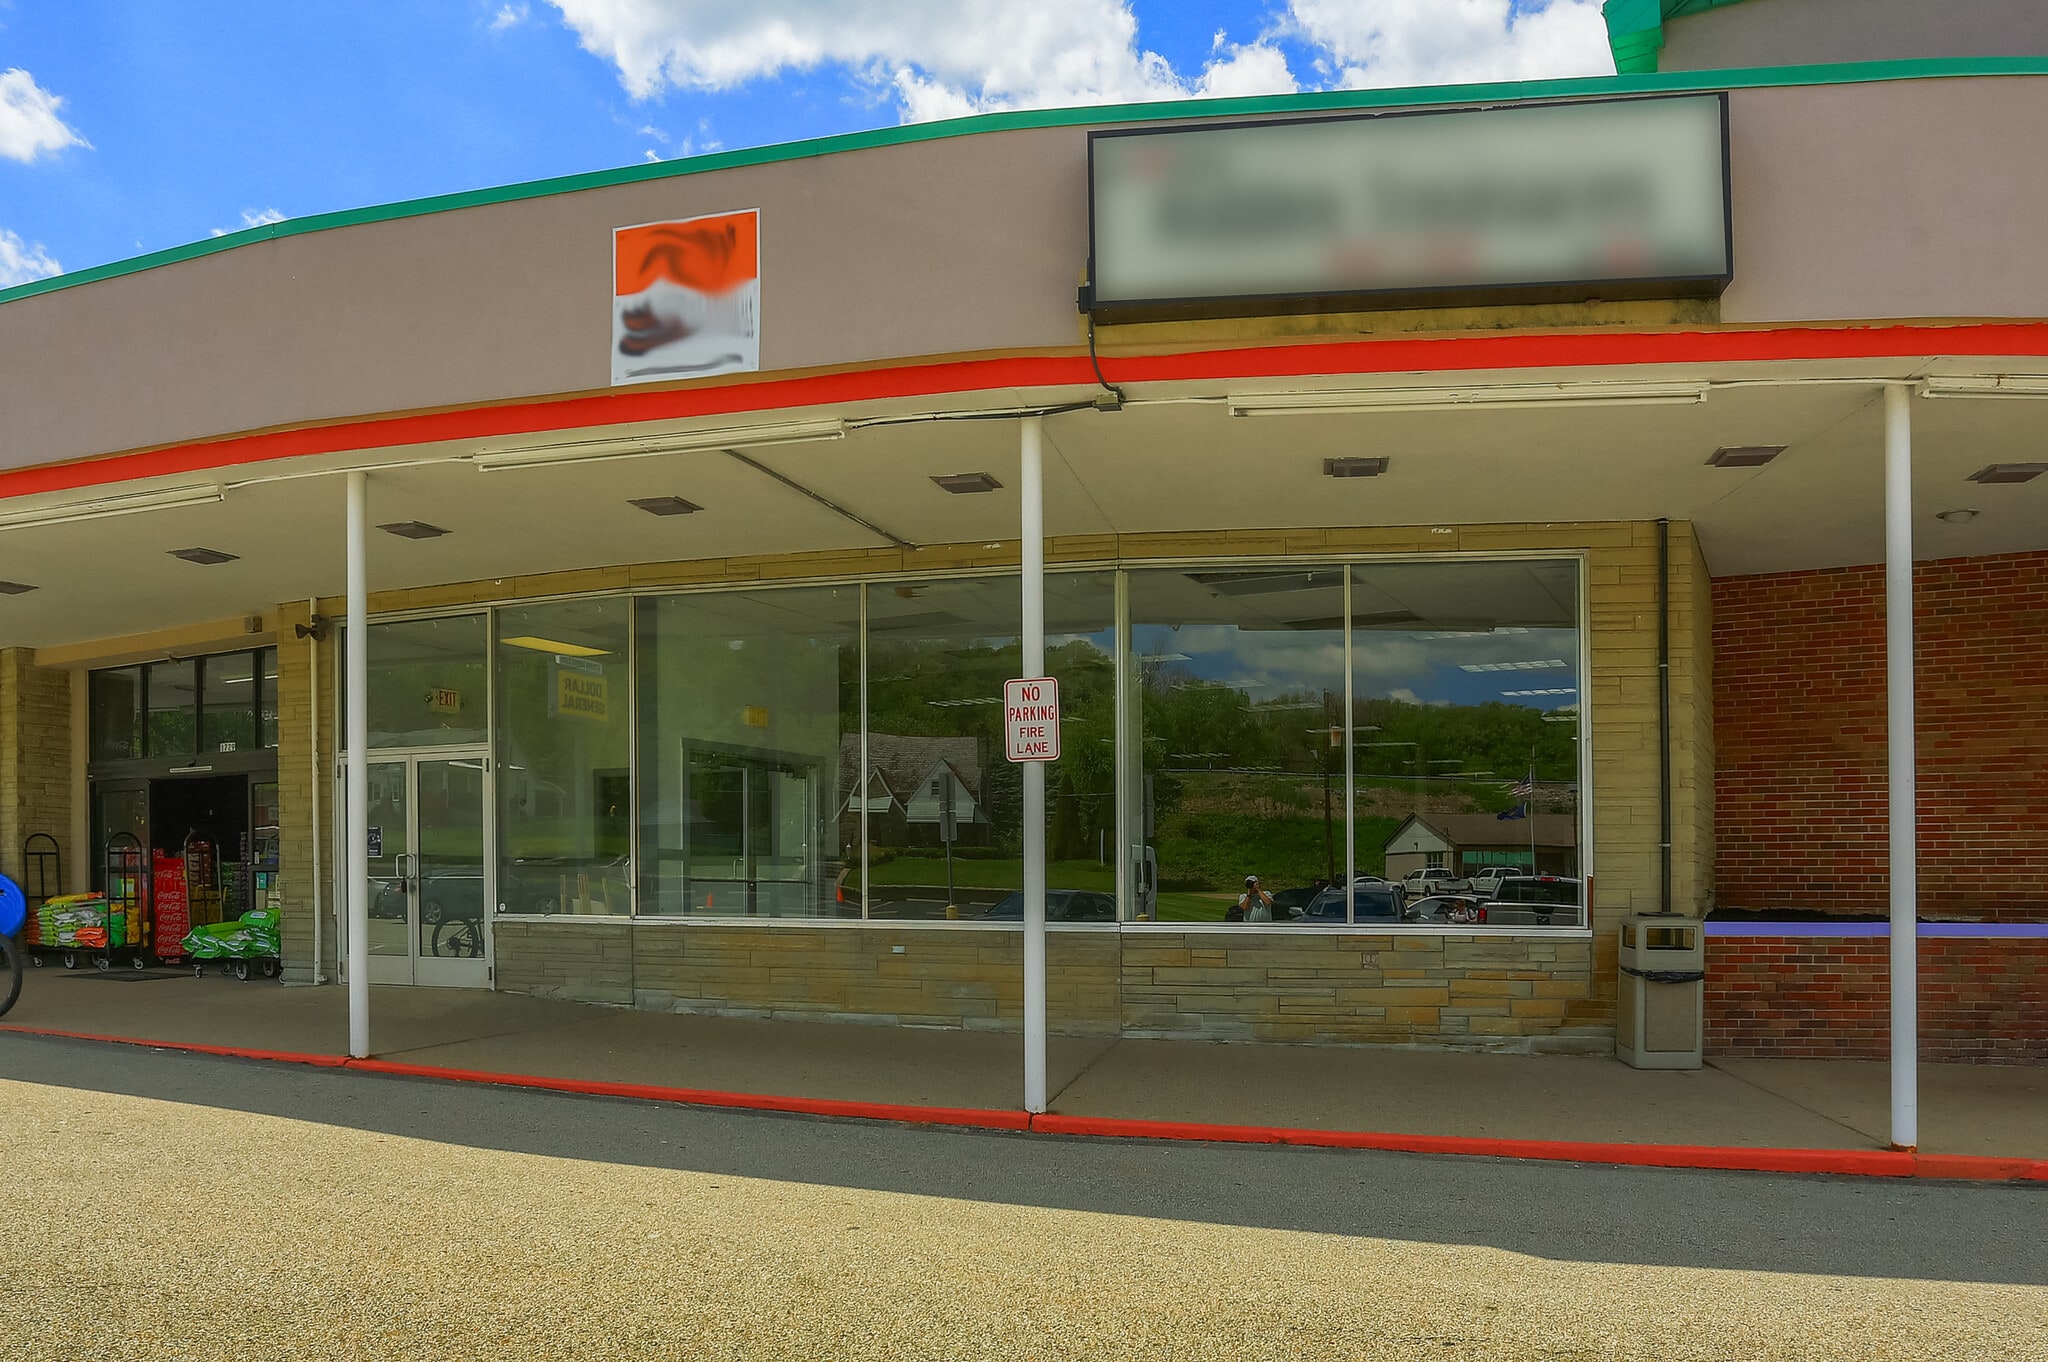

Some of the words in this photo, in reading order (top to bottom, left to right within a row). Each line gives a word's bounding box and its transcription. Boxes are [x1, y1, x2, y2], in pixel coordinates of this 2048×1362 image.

[439, 690, 457, 707] EXIT
[1021, 686, 1041, 702] NO
[1009, 705, 1055, 722] PARKING
[1019, 726, 1045, 738] FIRE
[1016, 741, 1049, 754] LANE
